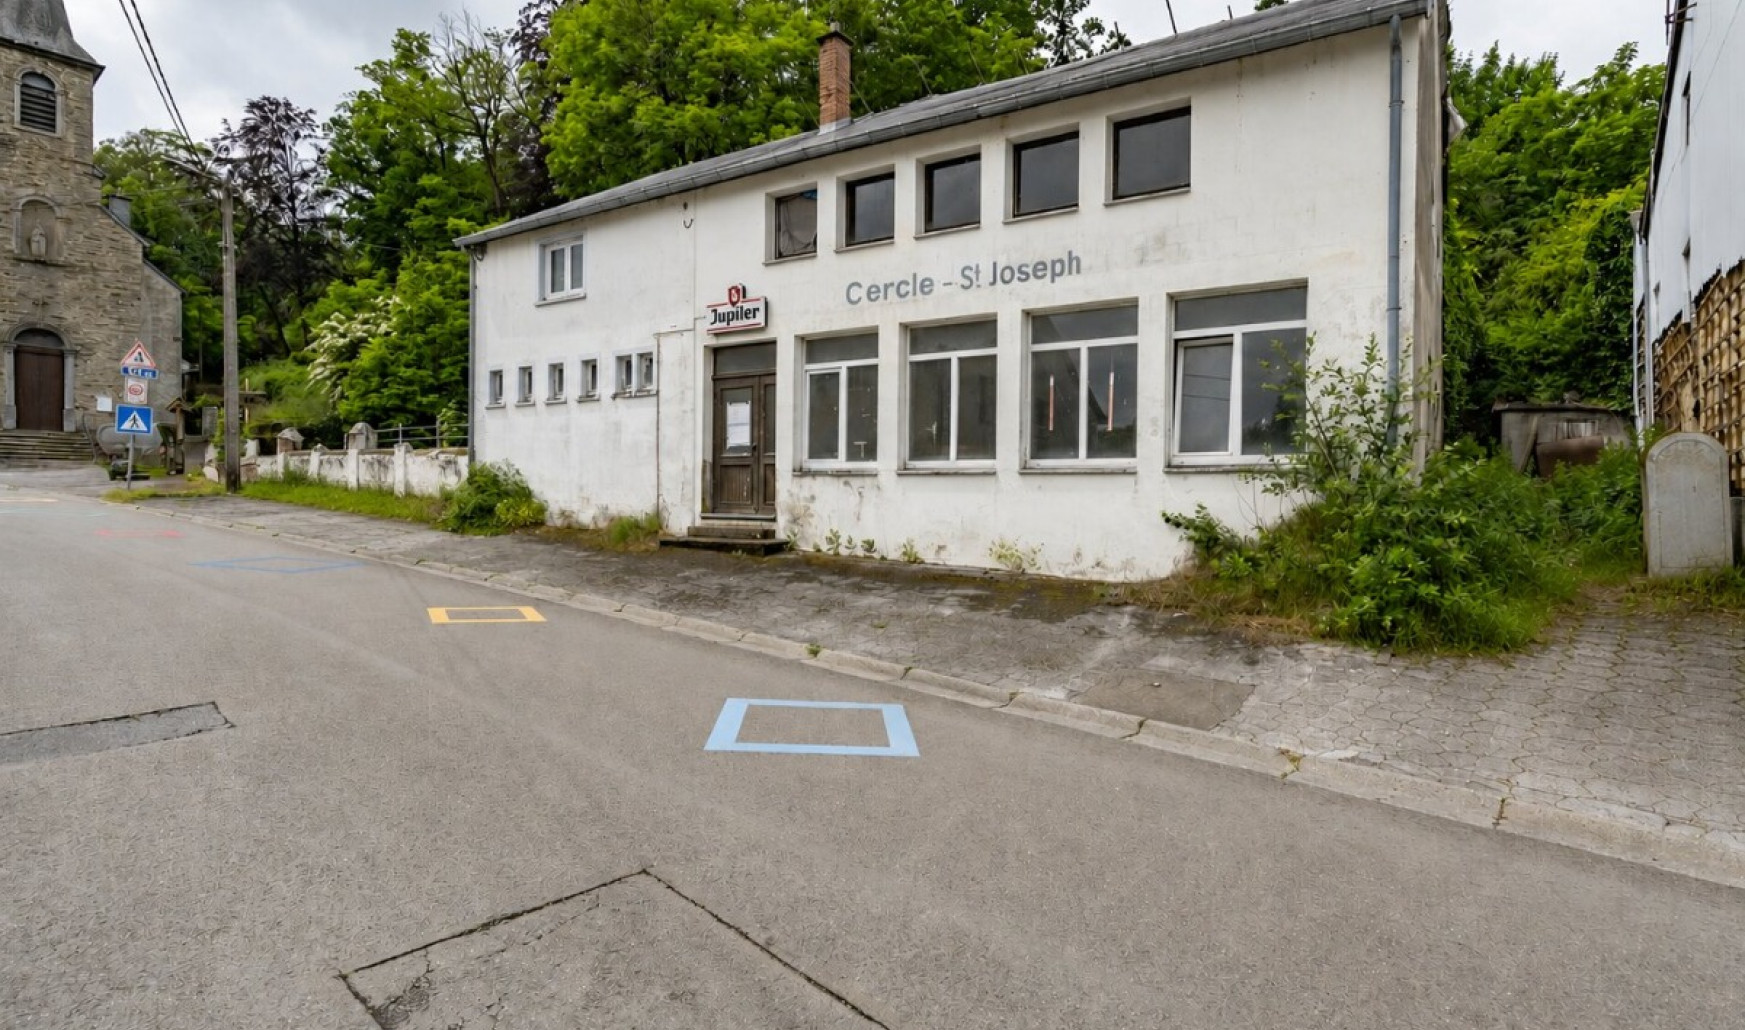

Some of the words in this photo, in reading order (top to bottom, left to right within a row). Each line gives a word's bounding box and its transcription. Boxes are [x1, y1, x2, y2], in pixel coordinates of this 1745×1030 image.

[846, 272, 935, 305] Cercle
[988, 250, 1082, 286] Joseph
[710, 305, 760, 326] Jupiler
